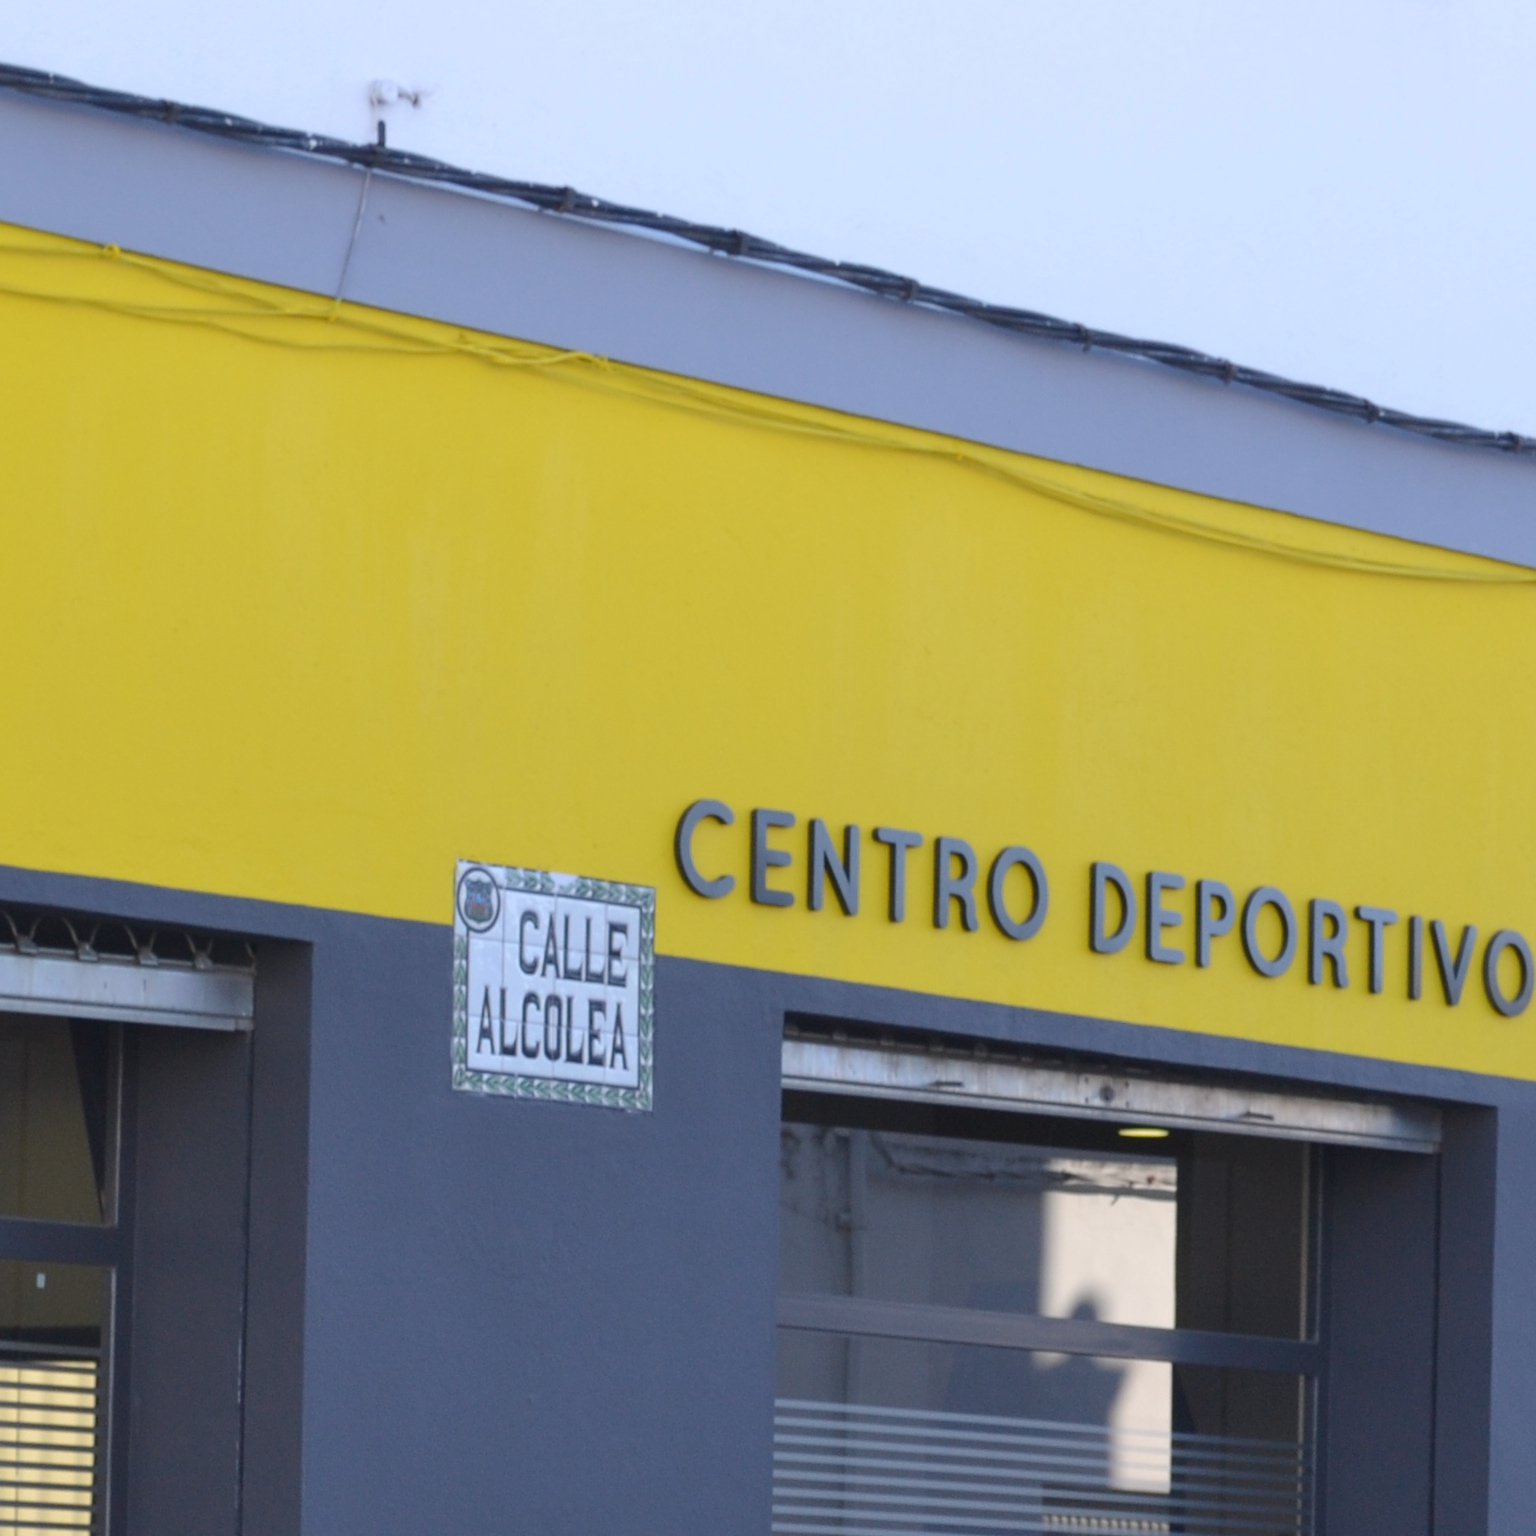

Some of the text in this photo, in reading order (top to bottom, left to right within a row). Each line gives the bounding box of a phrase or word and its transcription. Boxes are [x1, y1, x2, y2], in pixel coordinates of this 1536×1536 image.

[518, 908, 629, 988] CALLE
[675, 799, 1535, 1017] CENTRO DEPORTIVO
[475, 984, 631, 1072] ALCOLEA
